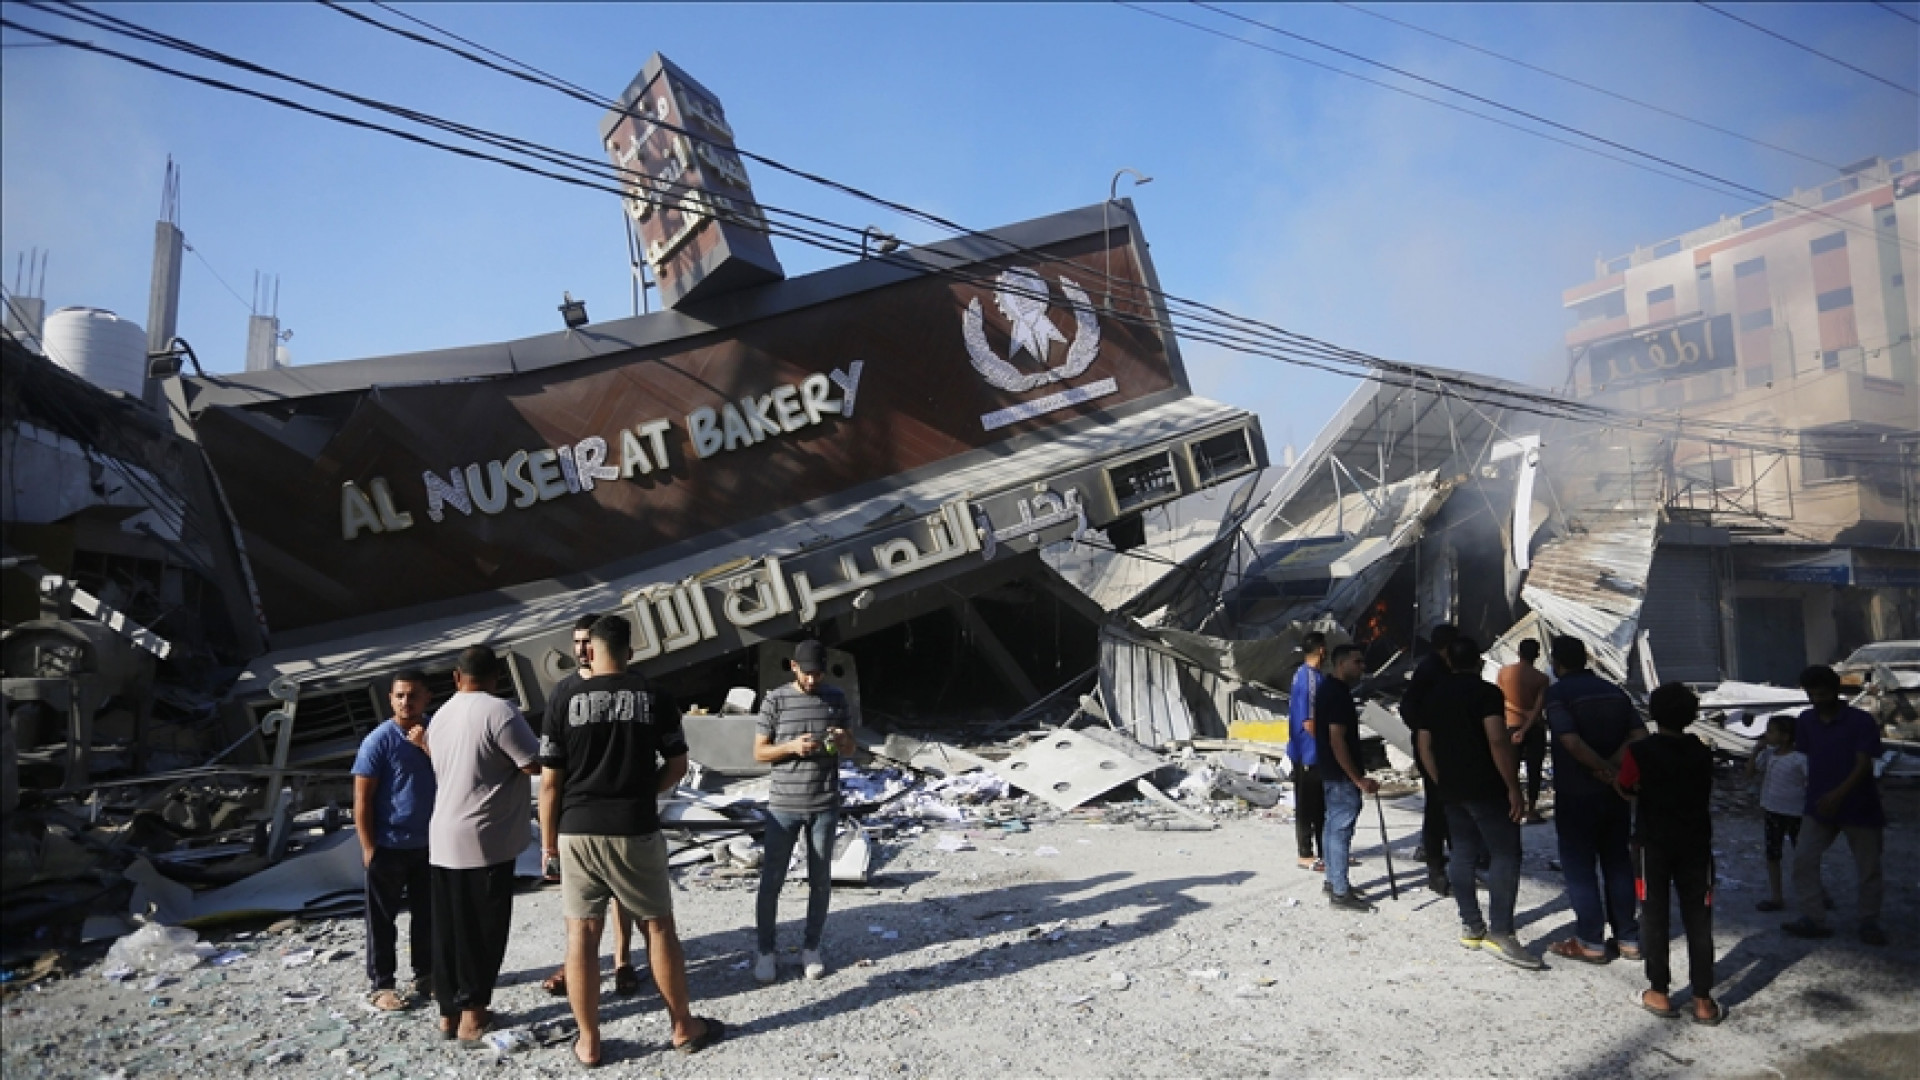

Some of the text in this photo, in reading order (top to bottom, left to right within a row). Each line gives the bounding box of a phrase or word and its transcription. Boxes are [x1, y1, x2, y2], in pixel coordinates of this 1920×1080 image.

[341, 359, 865, 541] AL NUSEIRAT BAKERY
